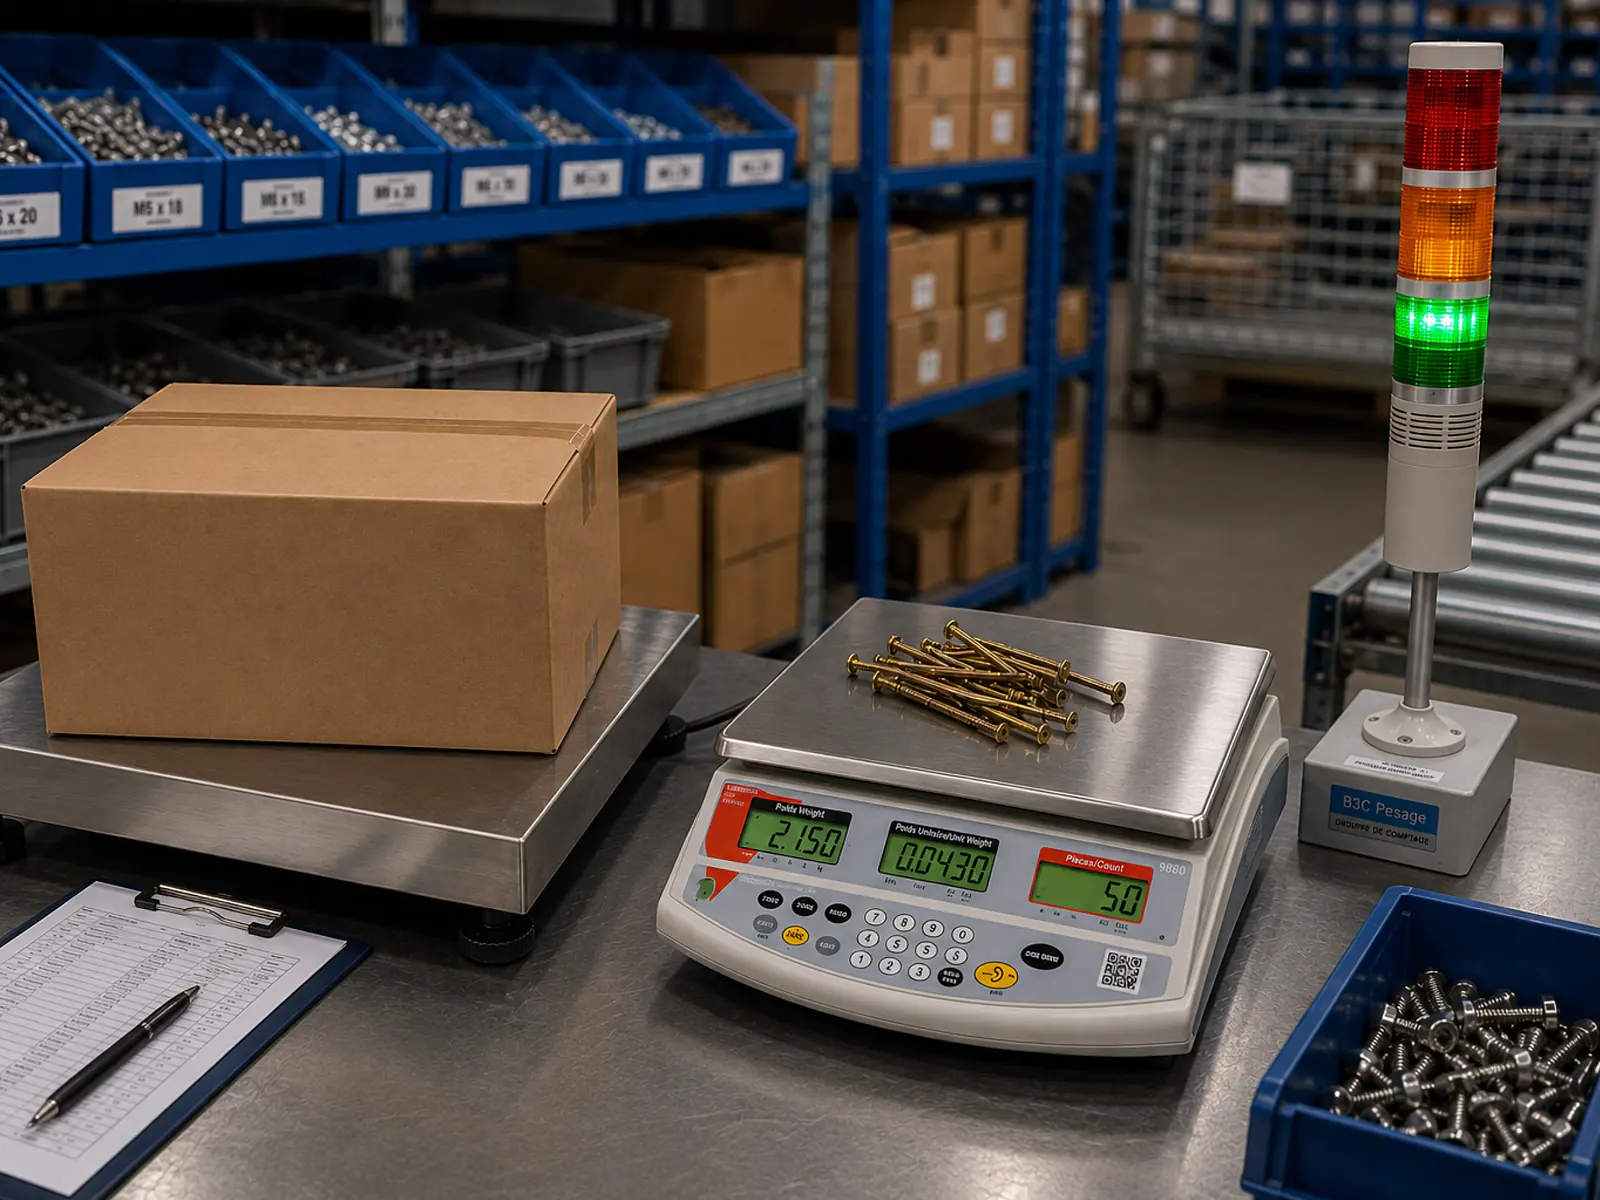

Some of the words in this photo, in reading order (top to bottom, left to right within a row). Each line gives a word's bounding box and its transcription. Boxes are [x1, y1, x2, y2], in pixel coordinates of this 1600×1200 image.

[7, 211, 16, 226] x
[19, 207, 37, 225] 20
[1343, 795, 1371, 812] B3C
[1376, 802, 1426, 825] Pesage
[768, 820, 842, 858] 2.150
[895, 842, 989, 884] 0.0430
[1100, 880, 1143, 916] 50
[872, 913, 880, 922] 7
[930, 923, 937, 933] 9
[886, 961, 894, 970] 2
[915, 967, 923, 977] 3
